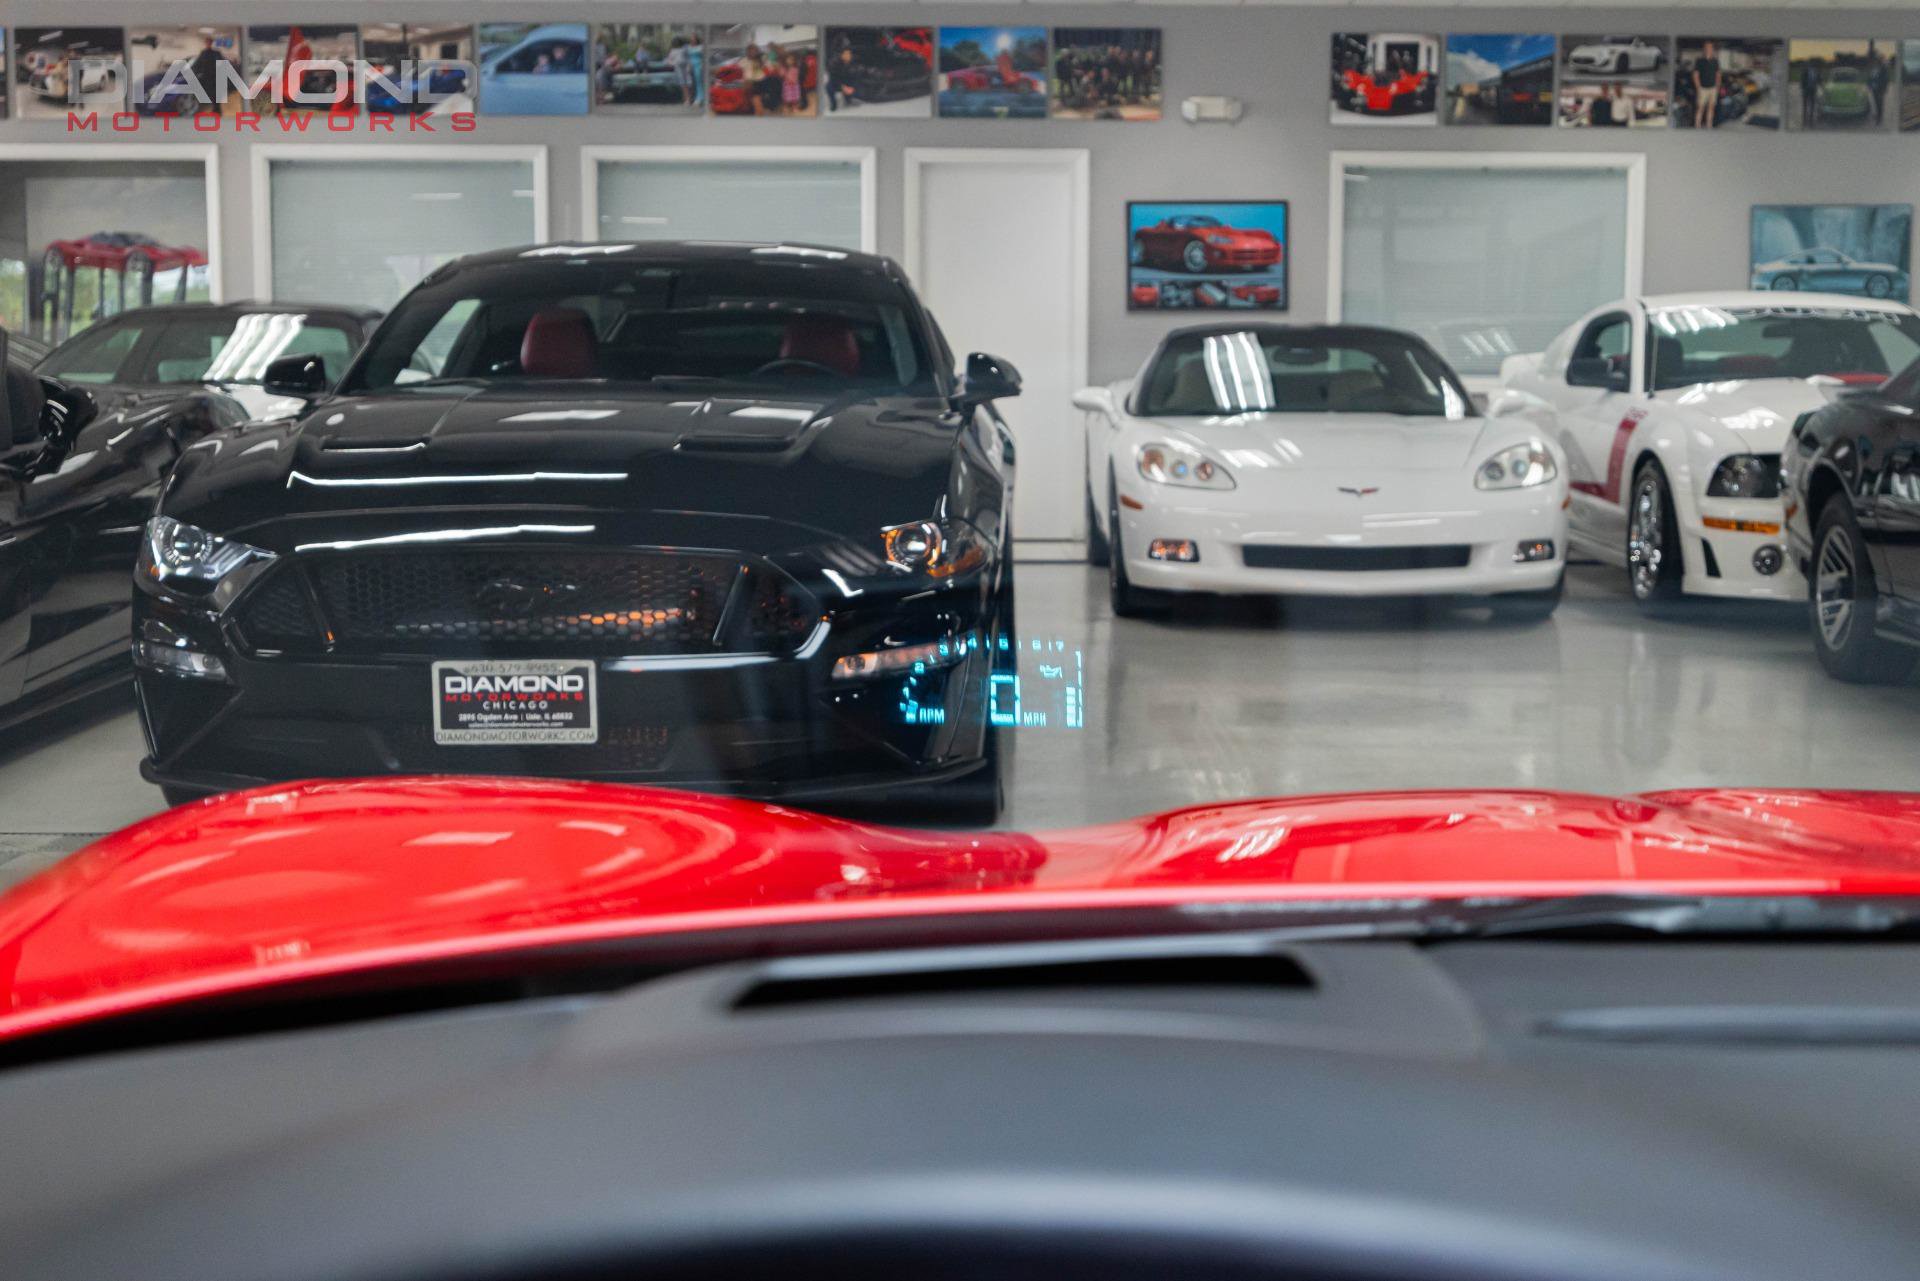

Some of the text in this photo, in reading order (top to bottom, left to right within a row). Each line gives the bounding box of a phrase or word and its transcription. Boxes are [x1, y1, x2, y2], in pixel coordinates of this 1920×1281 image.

[445, 674, 584, 693] DIAMOND
[445, 692, 584, 703] MOTORWORKS
[482, 700, 549, 710] CHICAGO
[919, 707, 945, 724] RPM
[1023, 711, 1047, 727] MPH
